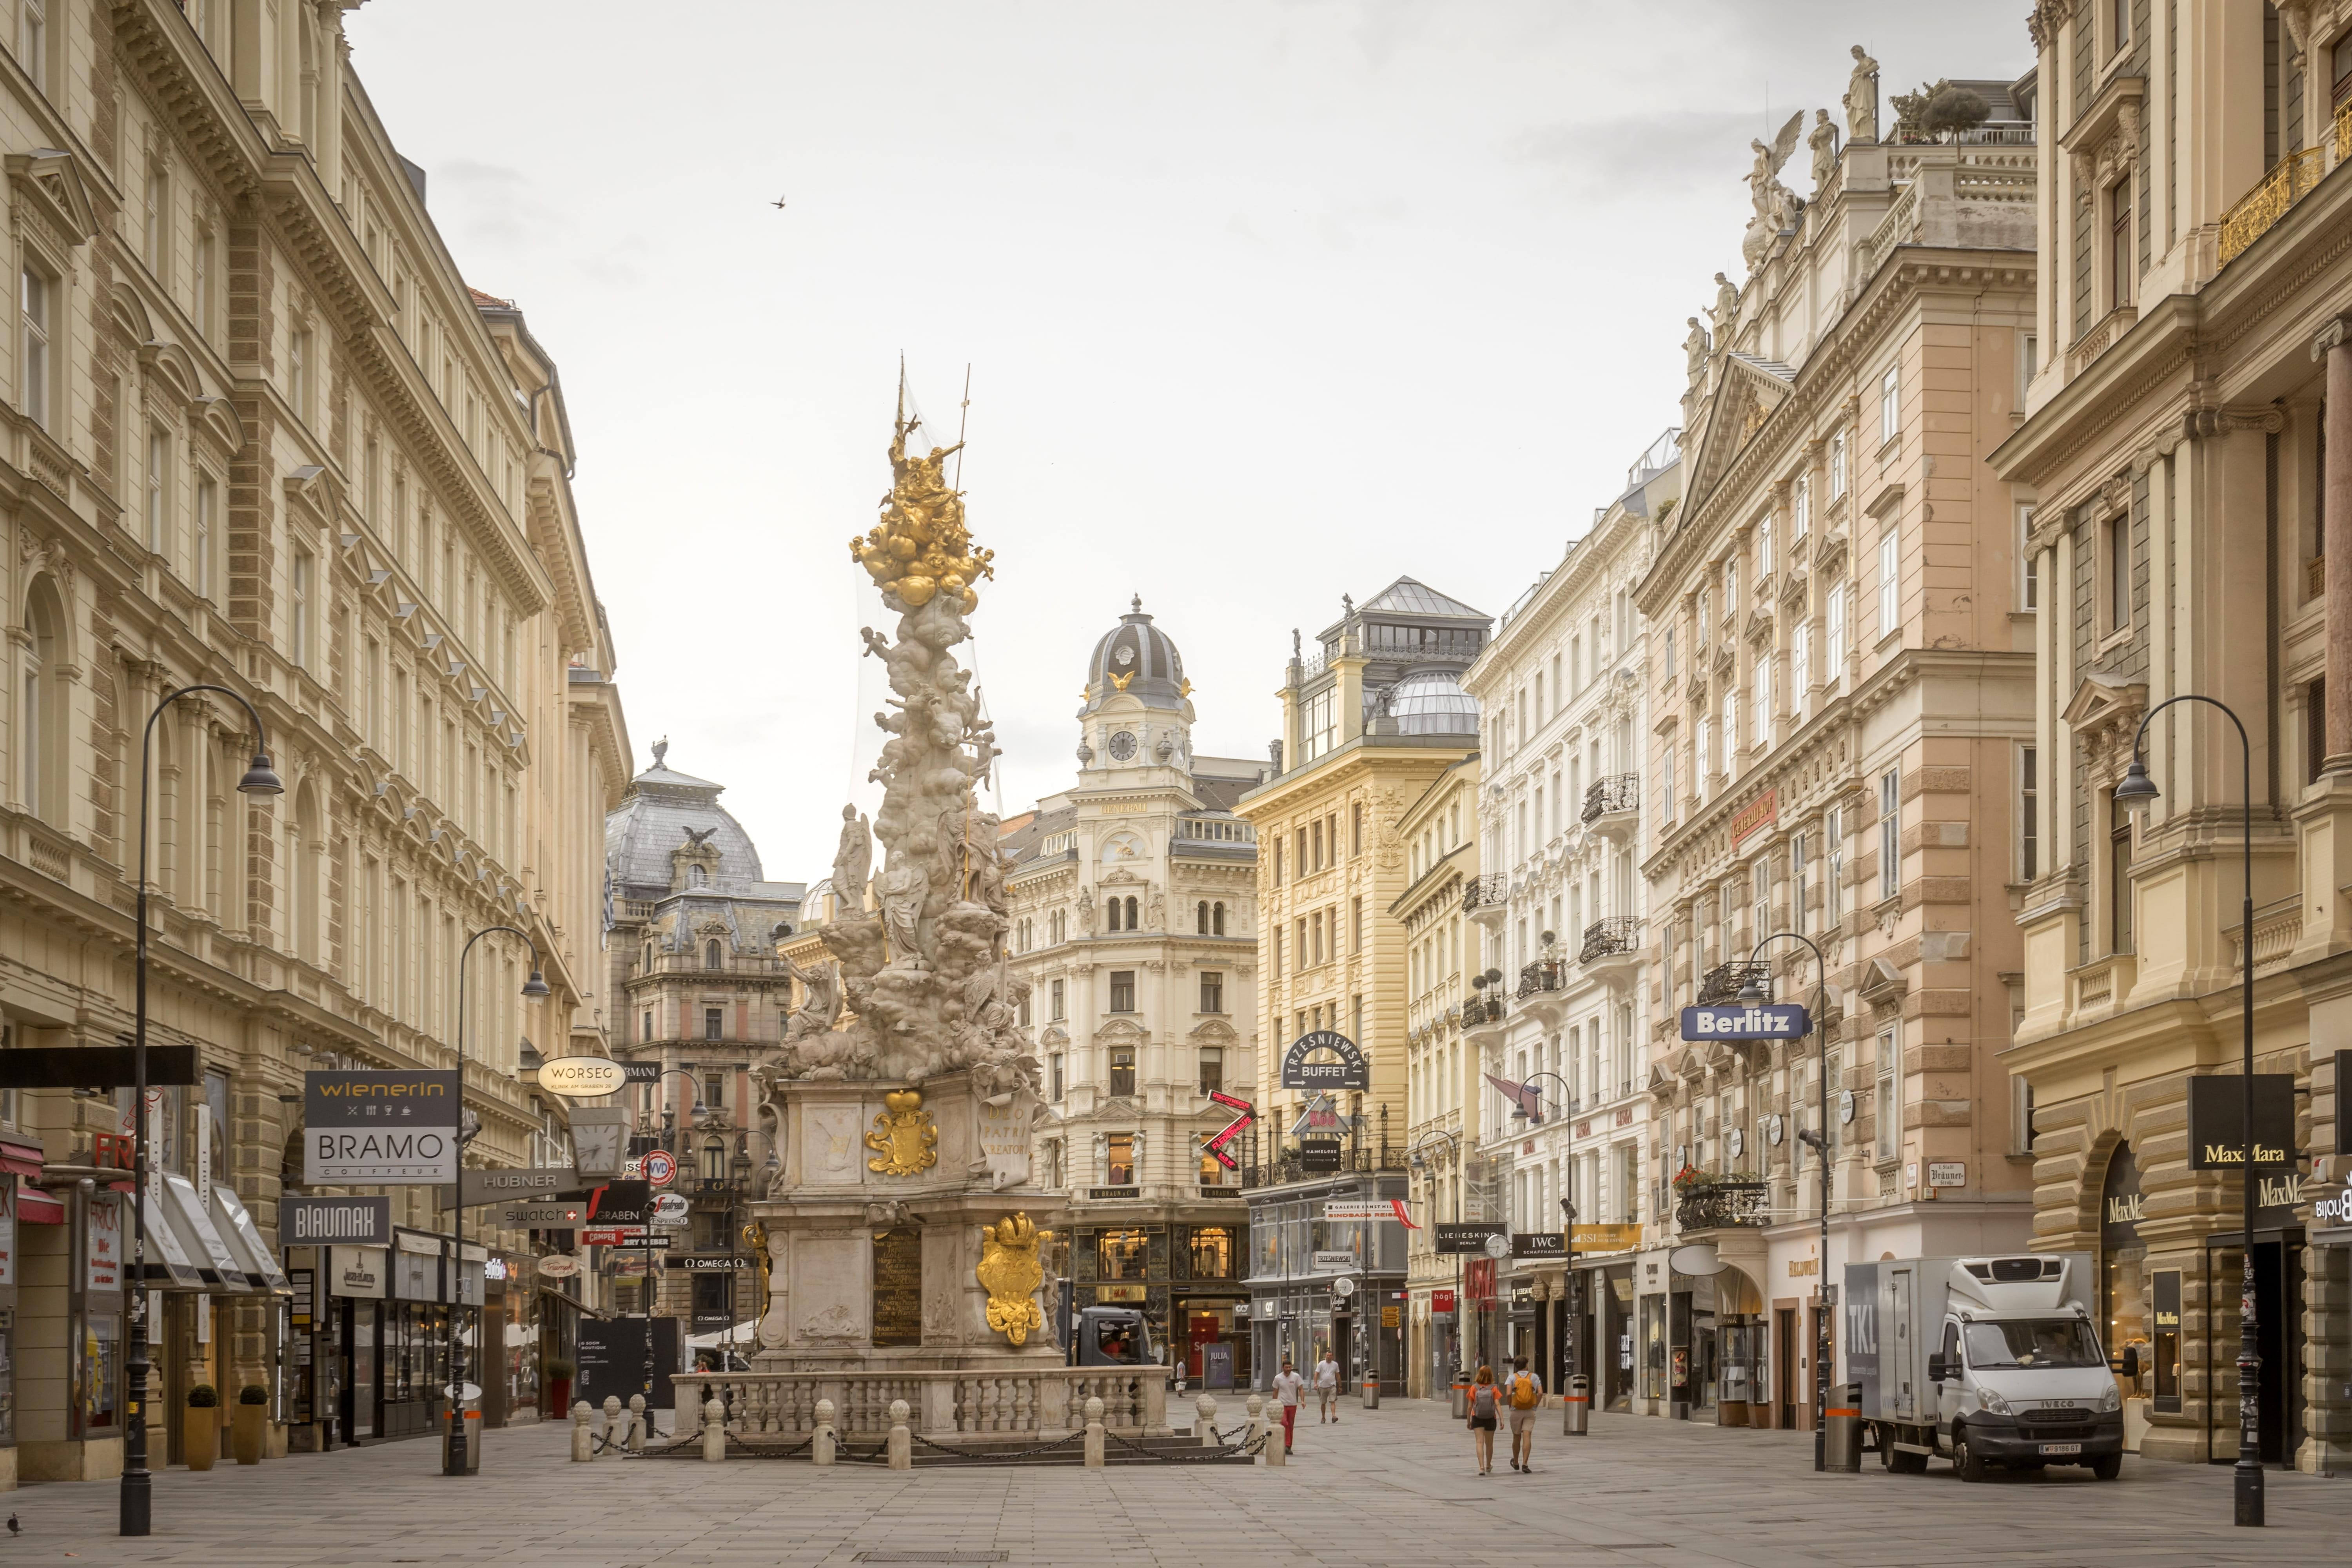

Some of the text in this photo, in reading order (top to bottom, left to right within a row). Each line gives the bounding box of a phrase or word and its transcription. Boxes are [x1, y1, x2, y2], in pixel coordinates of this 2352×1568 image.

[1100, 803, 1147, 814] GENERALI
[1697, 1009, 1789, 1033] Berlitz
[551, 1068, 612, 1078] WORSEG
[626, 1067, 655, 1076] RMANI
[1302, 1066, 1347, 1077] BUFFET
[320, 1082, 443, 1096] wienerin
[1212, 1092, 1250, 1109] DISCOTHEQUE
[989, 1106, 1024, 1120] DEO
[984, 1126, 1026, 1138] PATRI
[1211, 1116, 1252, 1151] FLEDERMAUS
[319, 1134, 443, 1159] BRAMO
[1218, 1152, 1229, 1163] BAR
[2204, 1144, 2285, 1162] MaxMara
[1931, 1169, 1964, 1181] Bräuner-
[484, 1175, 557, 1188] HÜBNER
[2258, 1174, 2306, 1207] MaxMa
[654, 1197, 685, 1213] Segafredo
[2109, 1194, 2147, 1223] MaxMa
[2316, 1199, 2341, 1220] BIJOU
[506, 1209, 565, 1221] swatch
[596, 1211, 639, 1220] GRABEN
[589, 1233, 616, 1242] CAMPER
[1532, 1237, 1556, 1247] IWC
[542, 1261, 573, 1273] Triumph
[1789, 1258, 1819, 1277] HELDWEIN
[1434, 1293, 1452, 1301] högl
[2156, 1312, 2179, 1324] MaxMara
[1849, 1305, 1877, 1354] TKL
